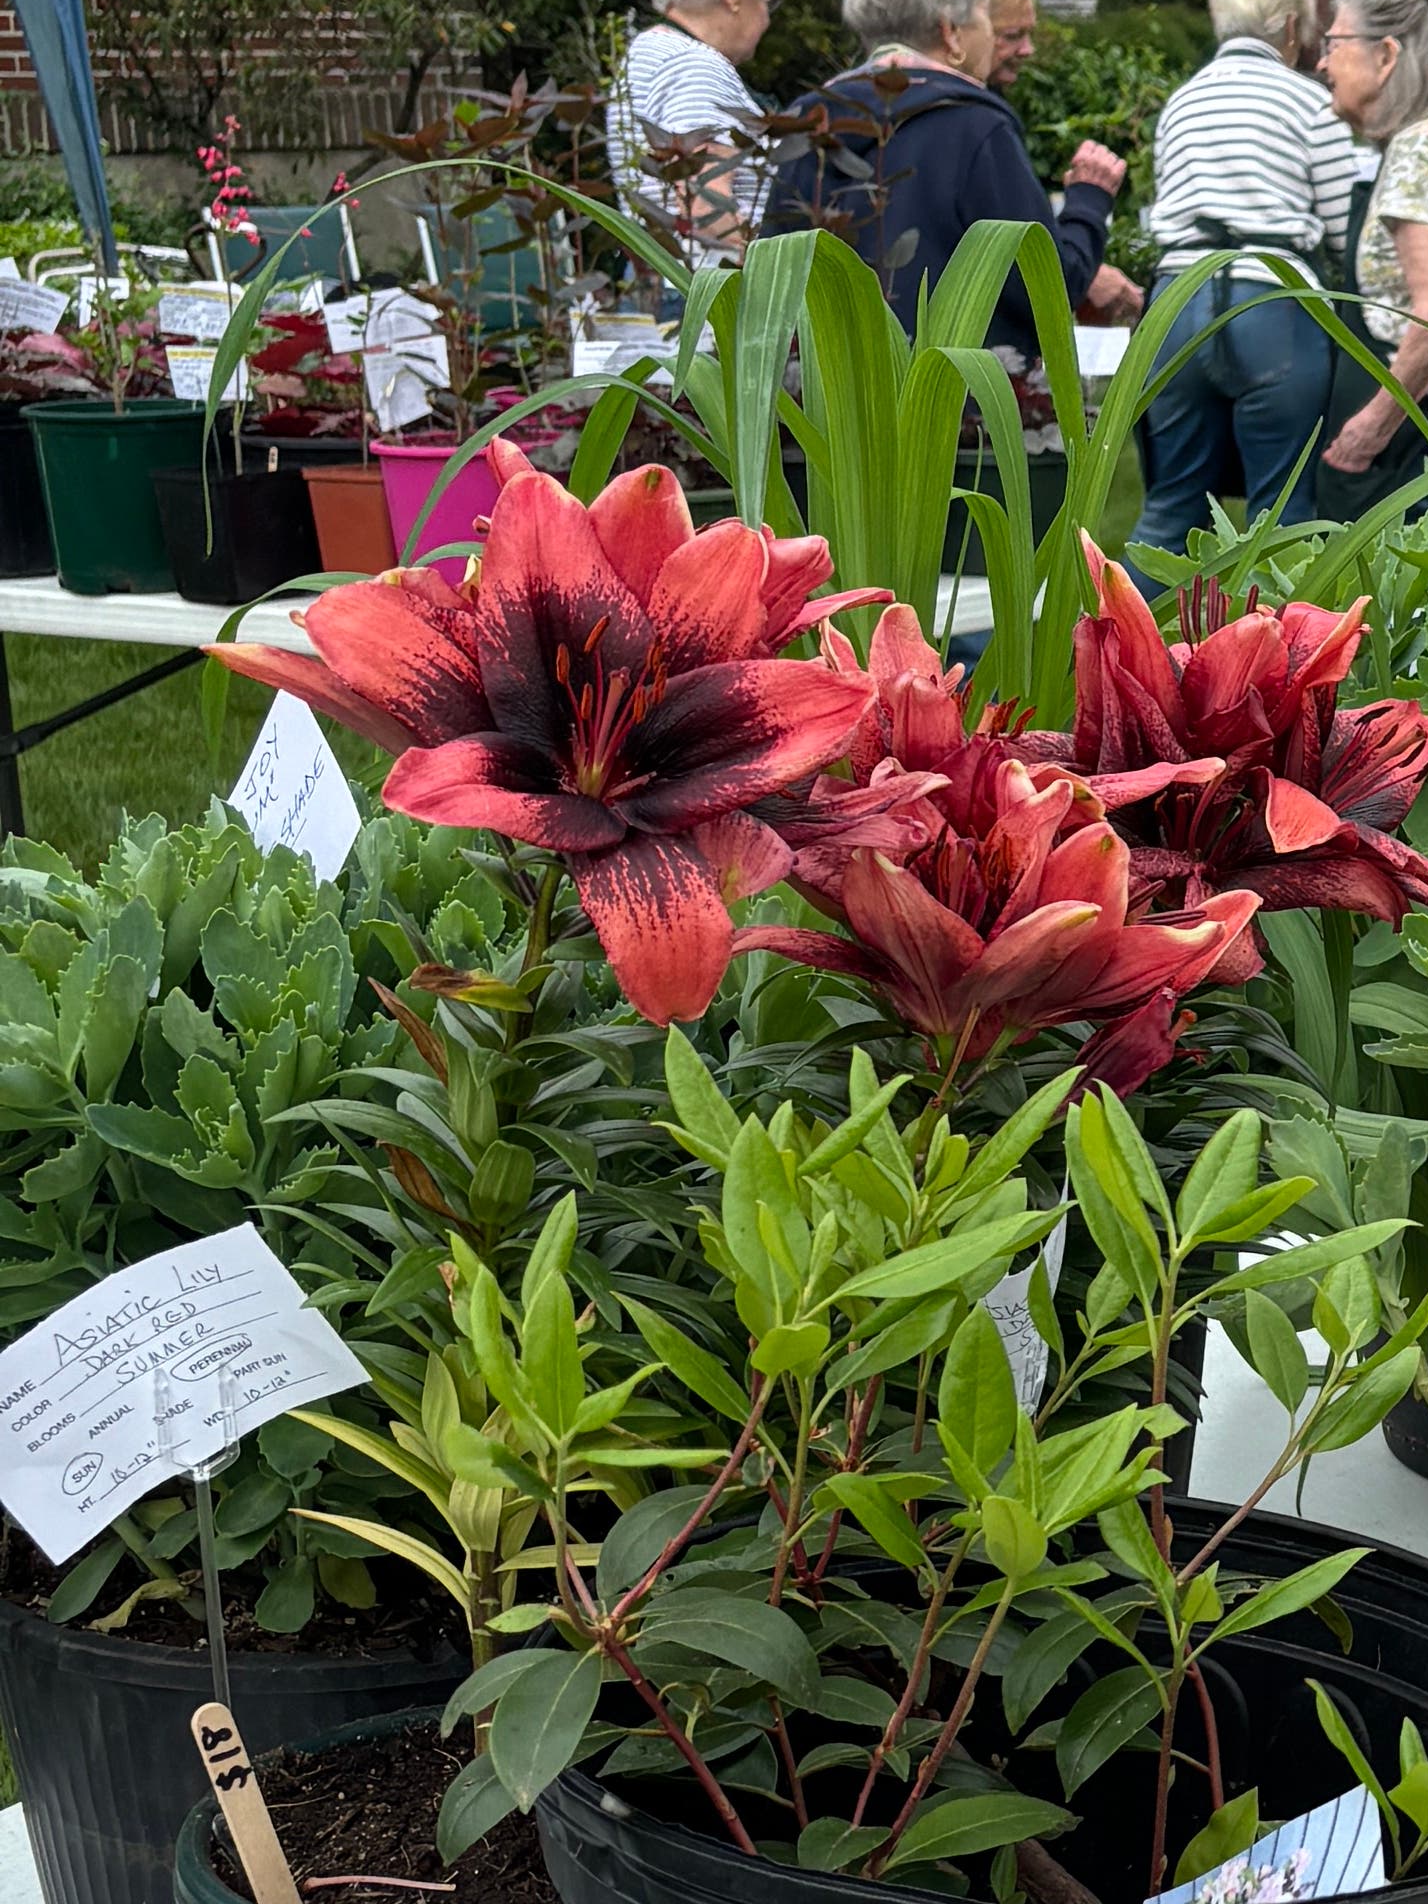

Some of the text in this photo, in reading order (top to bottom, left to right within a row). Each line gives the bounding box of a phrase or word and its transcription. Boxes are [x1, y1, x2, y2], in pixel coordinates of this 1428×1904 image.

[0, 1263, 223, 1414] NAME ASIATIC LILY
[11, 1302, 197, 1432] COLOR DARK RED
[26, 1322, 215, 1453] BLOOMS SUMMER
[71, 1460, 98, 1484] SUN
[232, 1359, 263, 1380] PART
[87, 1405, 136, 1440] ANNUAL
